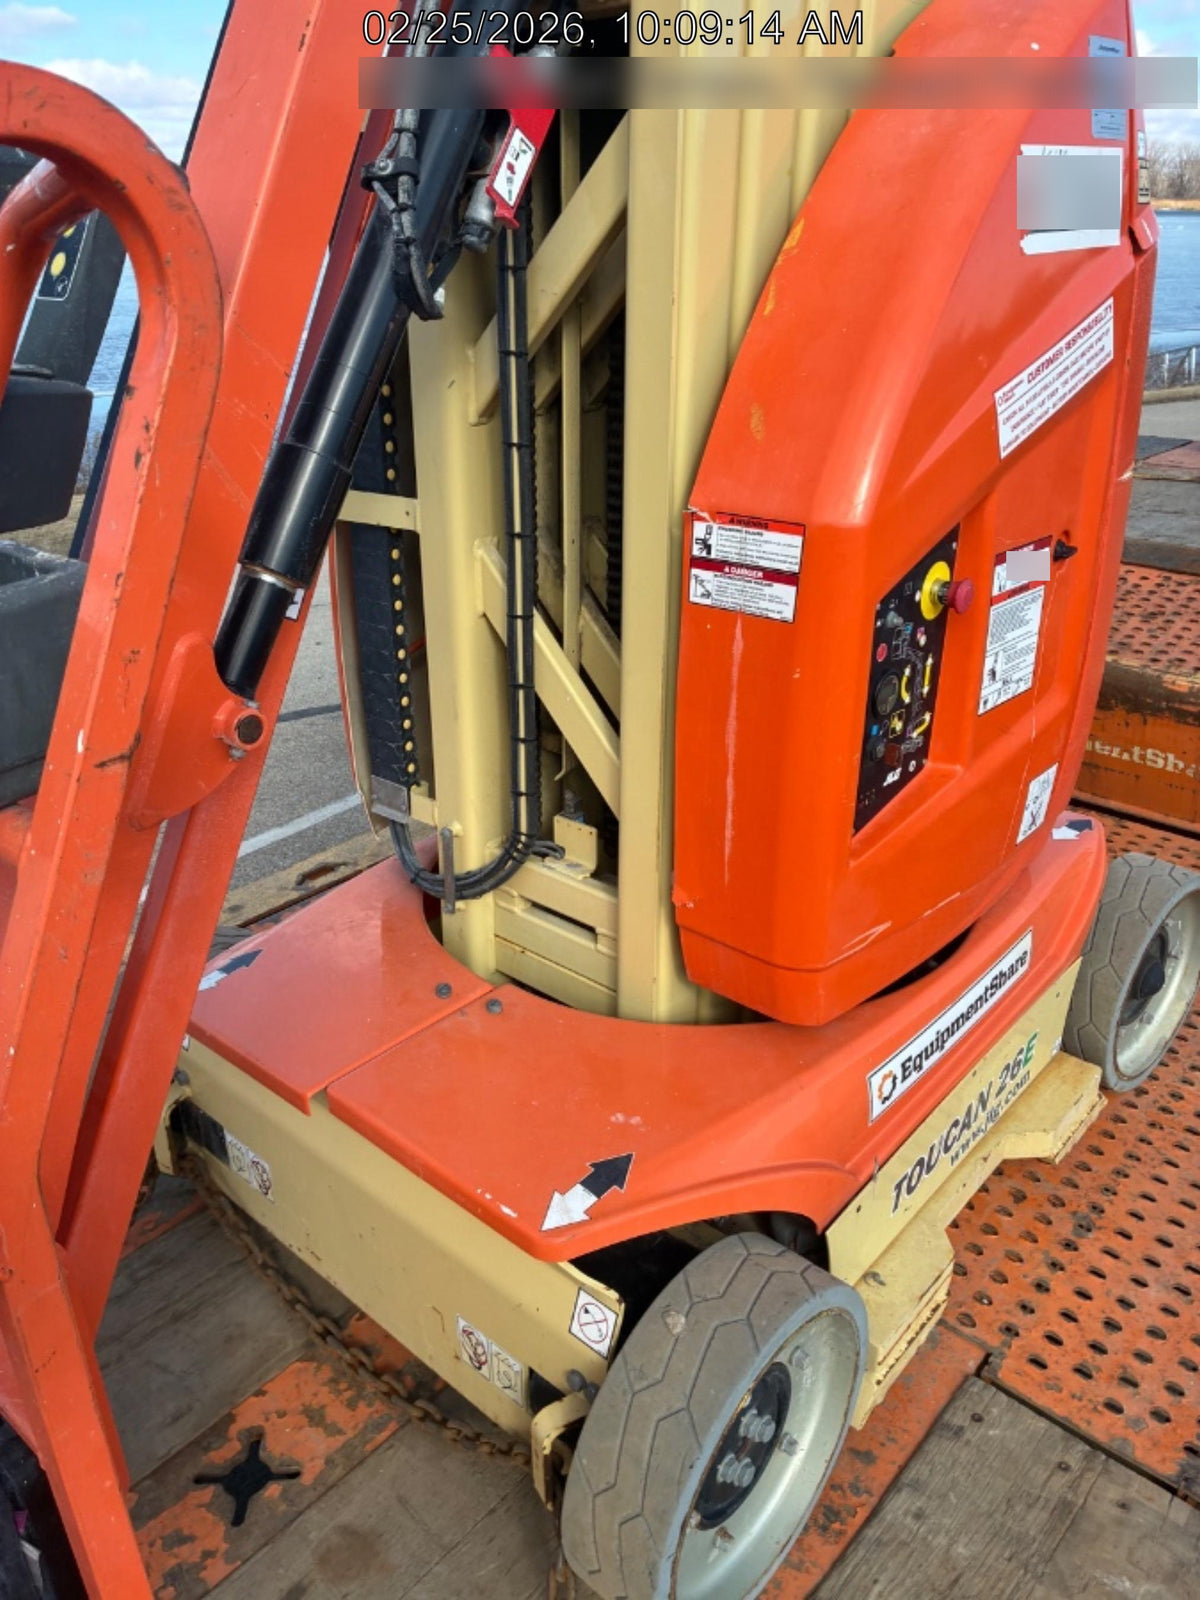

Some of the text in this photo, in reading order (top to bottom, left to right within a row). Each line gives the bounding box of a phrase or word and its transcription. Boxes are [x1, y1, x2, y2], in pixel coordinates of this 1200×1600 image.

[1027, 346, 1065, 384] CUSTOMER
[730, 566, 764, 578] DANGER
[900, 950, 1029, 1084] EquipmentShare
[891, 1032, 1039, 1214] TOUCAN 26E
[950, 1069, 1031, 1167] www.jlg.com
